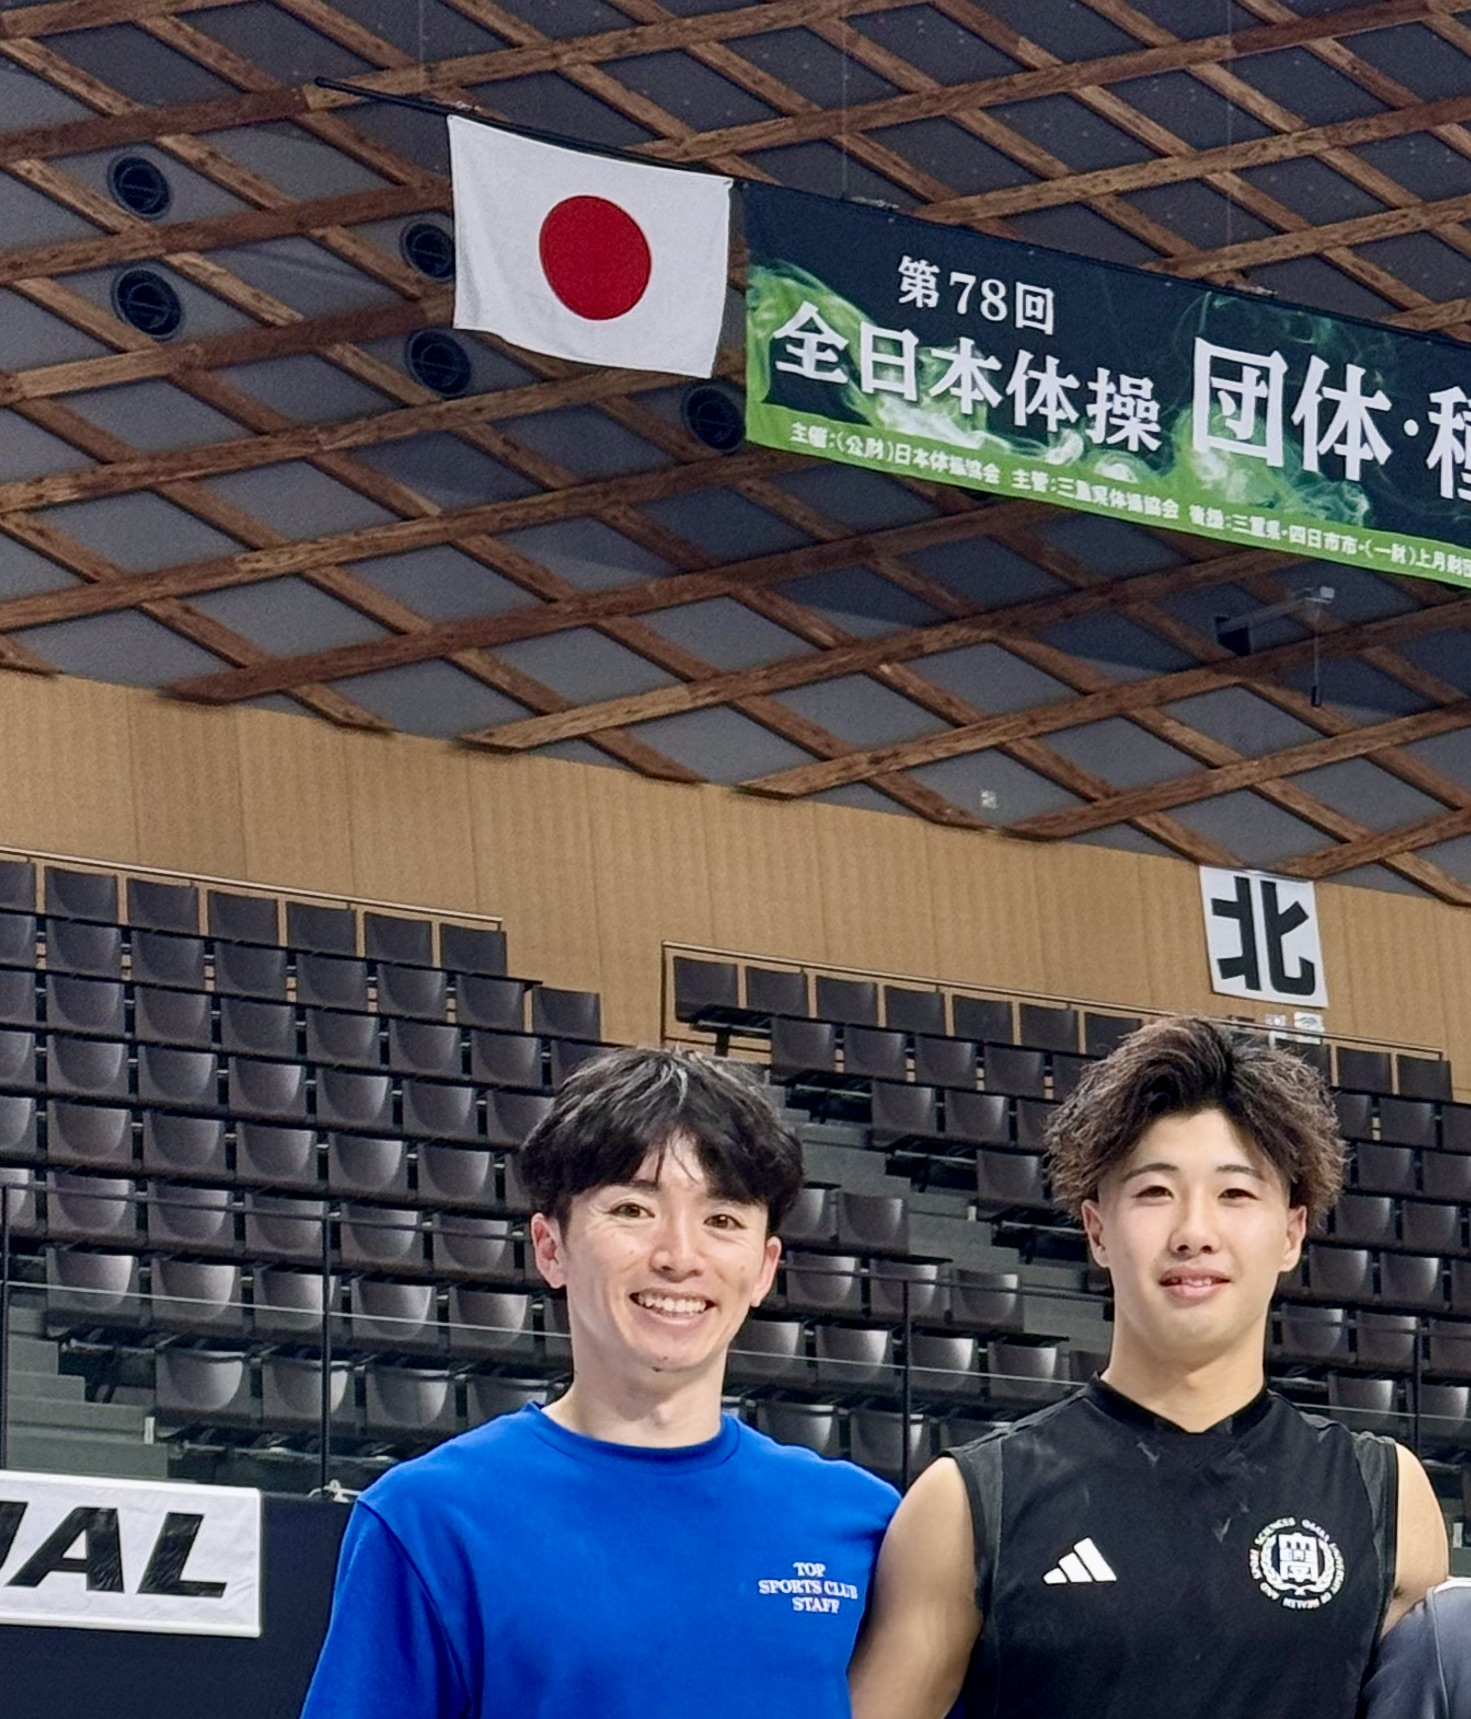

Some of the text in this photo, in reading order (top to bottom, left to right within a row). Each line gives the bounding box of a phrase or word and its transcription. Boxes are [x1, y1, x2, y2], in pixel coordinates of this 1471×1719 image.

[898, 254, 1055, 336] 第78回
[773, 300, 1162, 453] 全日本体操
[1211, 876, 1316, 996] 北
[758, 1579, 858, 1600] SPORTS CLUB
[793, 1562, 826, 1578] TOP
[792, 1596, 840, 1614] STAFF
